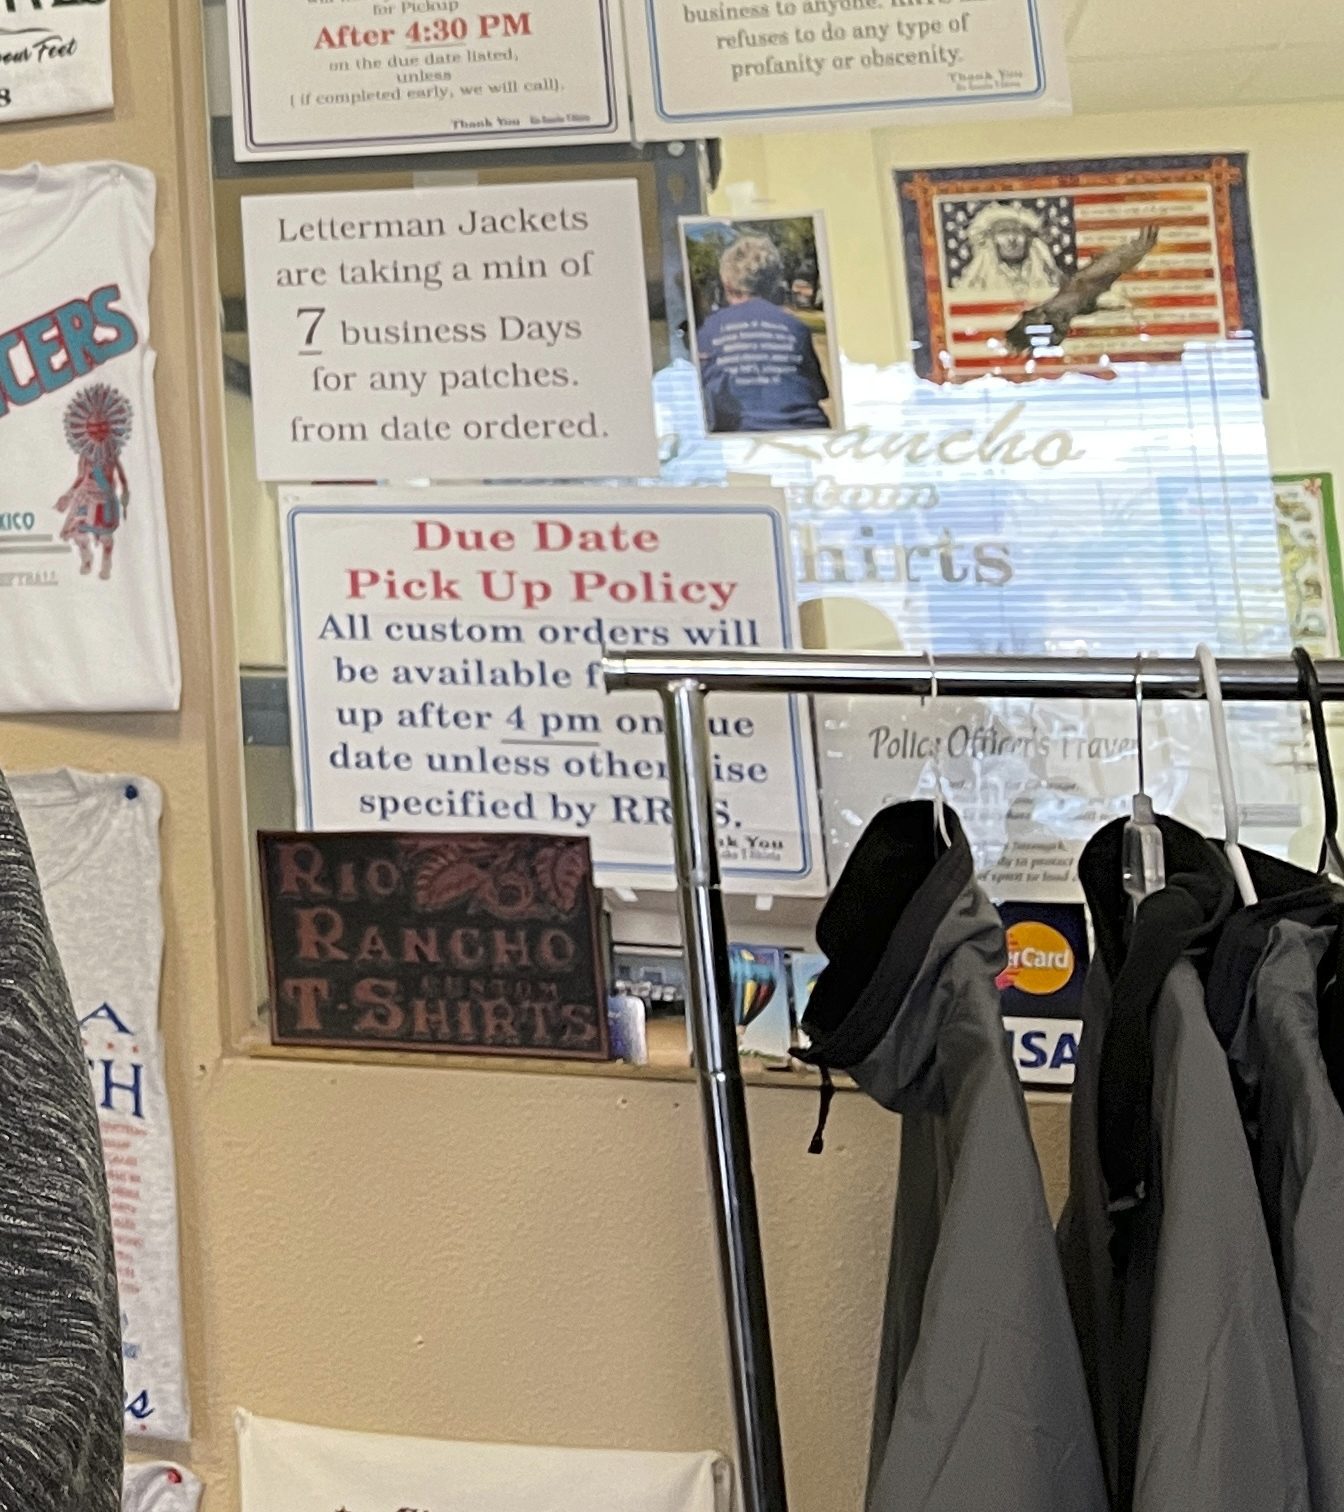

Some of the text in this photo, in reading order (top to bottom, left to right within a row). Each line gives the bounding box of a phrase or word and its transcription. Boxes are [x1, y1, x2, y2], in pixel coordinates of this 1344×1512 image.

[313, 11, 533, 50] After 4:30 PM
[277, 206, 590, 244] Letterman Jackets
[276, 249, 595, 291] are taking a min of
[340, 315, 583, 347] business Days
[312, 362, 580, 398] for any patches.
[290, 411, 610, 444] from date ordered.
[412, 519, 661, 554] Due Date
[344, 568, 739, 611] Pick Up Policy
[316, 613, 761, 647] All custom orders will
[334, 656, 574, 689] be available
[335, 701, 602, 740] up after 4 pm
[328, 742, 551, 776] date unless
[358, 787, 599, 829] specified by
